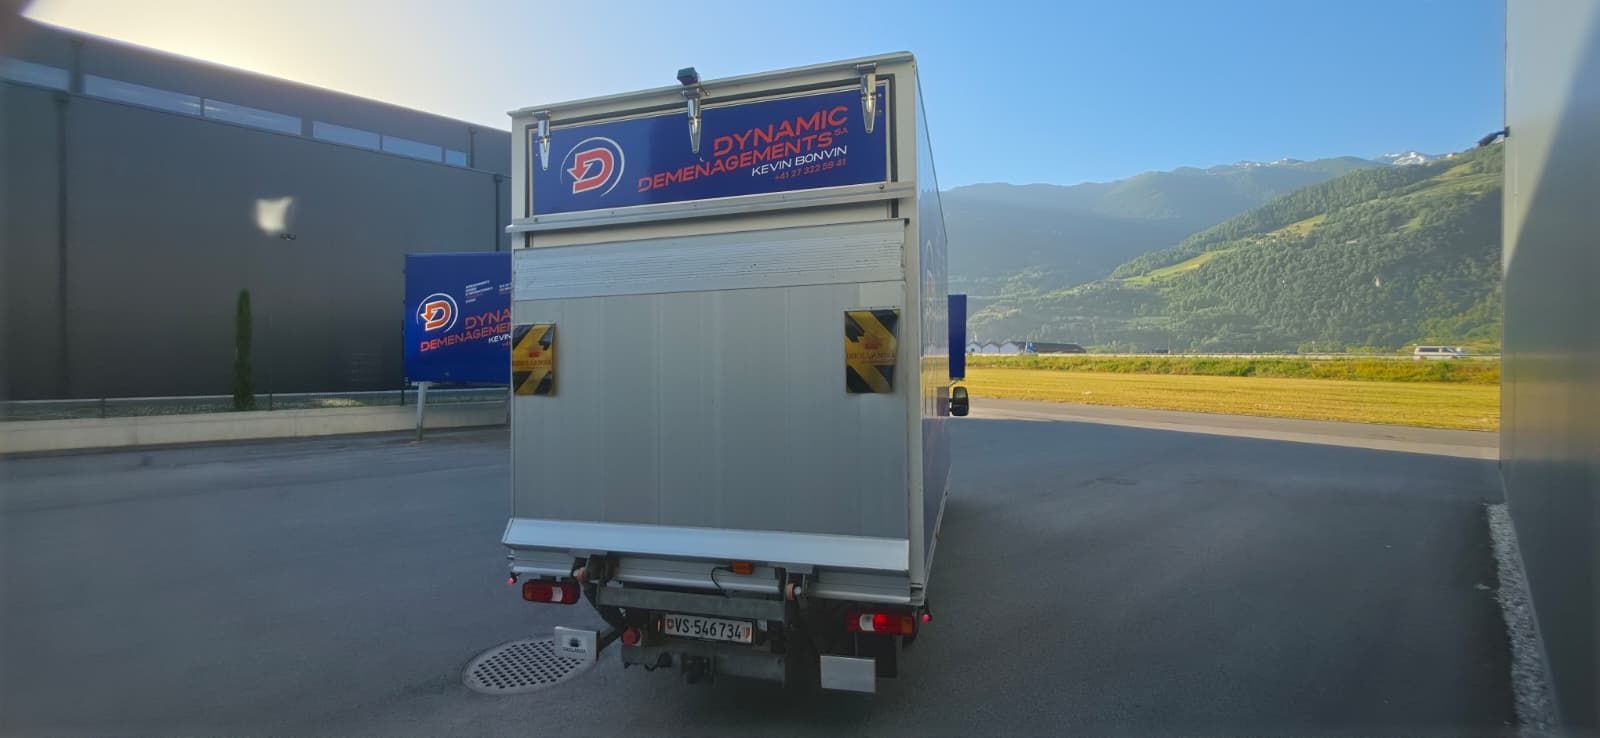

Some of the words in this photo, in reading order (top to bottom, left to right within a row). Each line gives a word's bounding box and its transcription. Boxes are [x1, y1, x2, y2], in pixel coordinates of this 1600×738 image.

[713, 106, 849, 157] DYNAMIC
[638, 132, 832, 192] DEMENAGEMENTS
[752, 158, 792, 176] KEVIN
[795, 145, 847, 166] BONVIN
